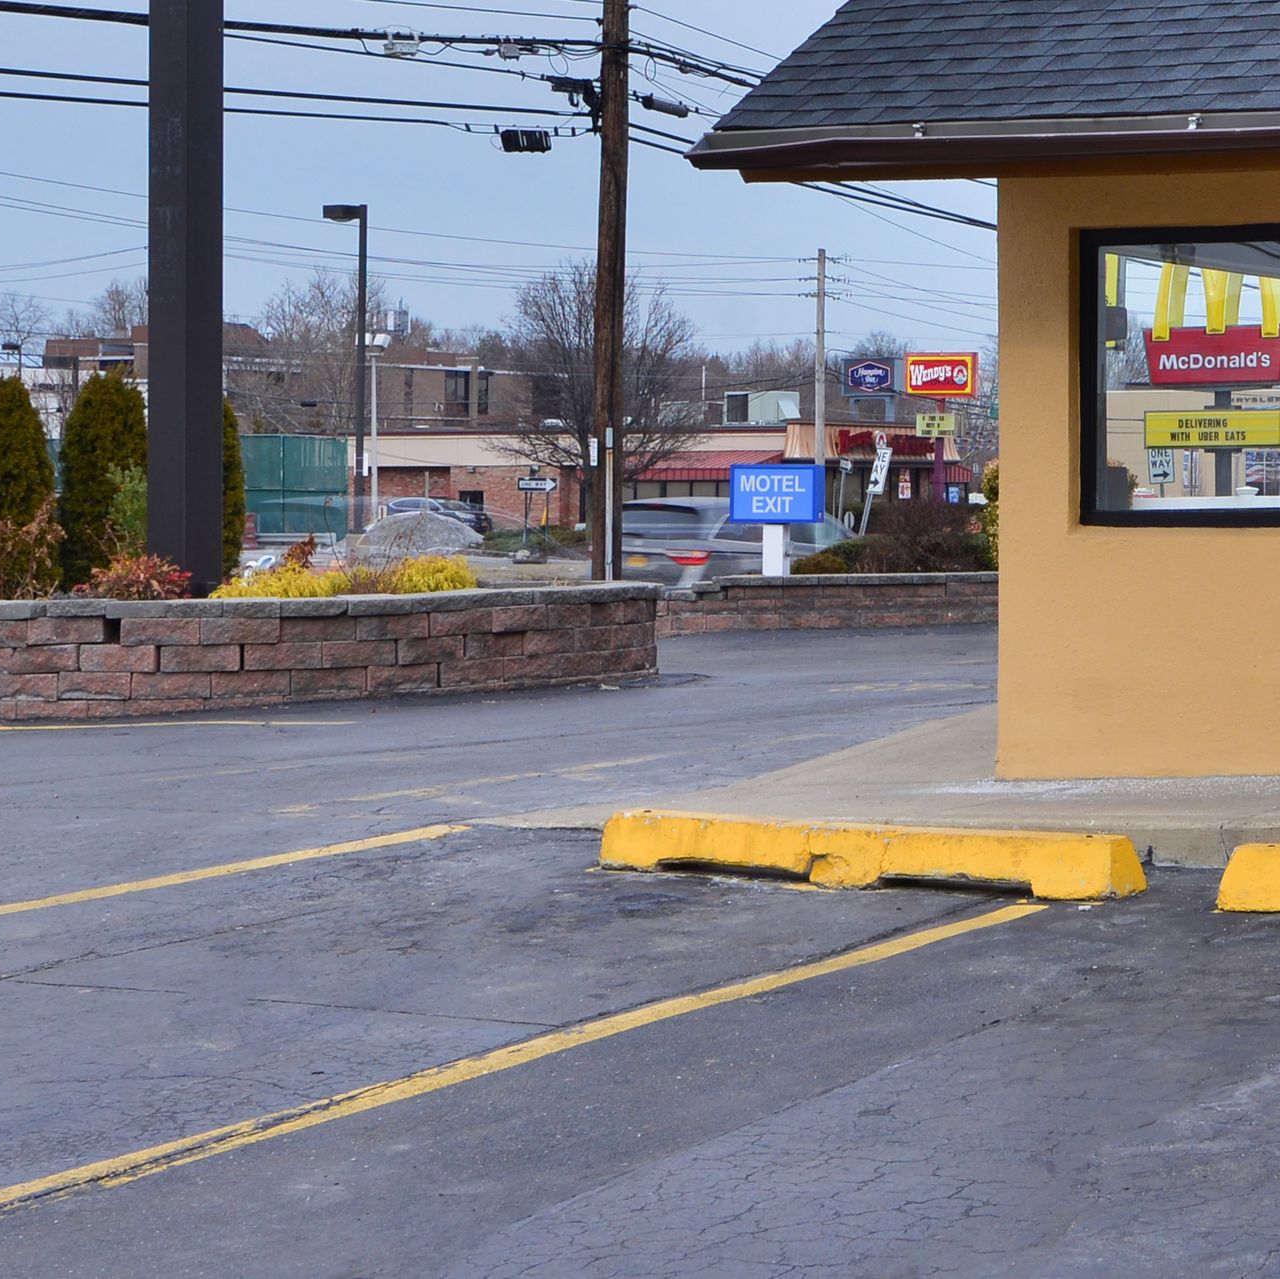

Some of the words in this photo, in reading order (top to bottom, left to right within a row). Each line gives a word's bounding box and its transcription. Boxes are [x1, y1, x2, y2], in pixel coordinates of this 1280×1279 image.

[1158, 351, 1271, 370] McDonald's
[1178, 418, 1228, 428] DELIVERING
[1170, 431, 1191, 442] WITH
[1198, 431, 1219, 441] UBER
[1225, 431, 1246, 441] EATS
[876, 451, 888, 463] NE
[1150, 448, 1170, 458] ONE
[1150, 458, 1171, 469] WAY
[872, 464, 886, 475] AY
[740, 474, 806, 493] MOTEL
[752, 496, 794, 513] EXIT
